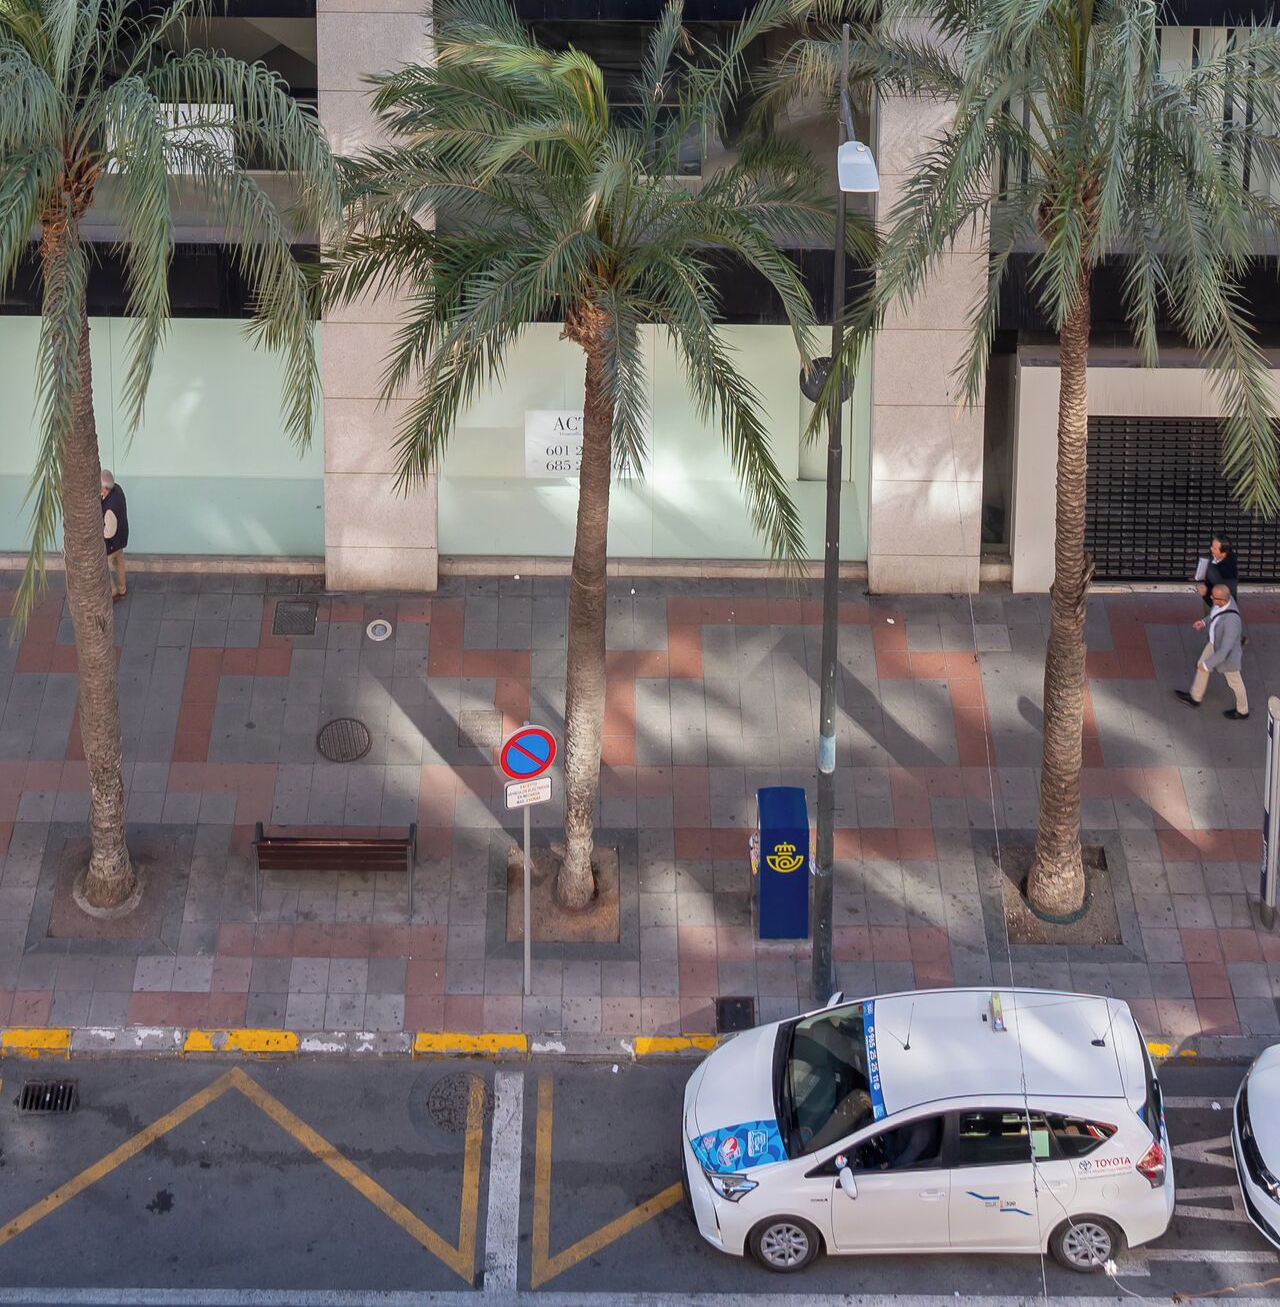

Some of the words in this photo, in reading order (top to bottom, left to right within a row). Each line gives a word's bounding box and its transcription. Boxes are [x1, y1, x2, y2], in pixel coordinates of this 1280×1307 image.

[546, 445, 569, 456] 601
[546, 460, 571, 471] 685
[869, 1049, 877, 1060] 25
[871, 1062, 878, 1072] 25
[1094, 1156, 1131, 1168] TOYOTA
